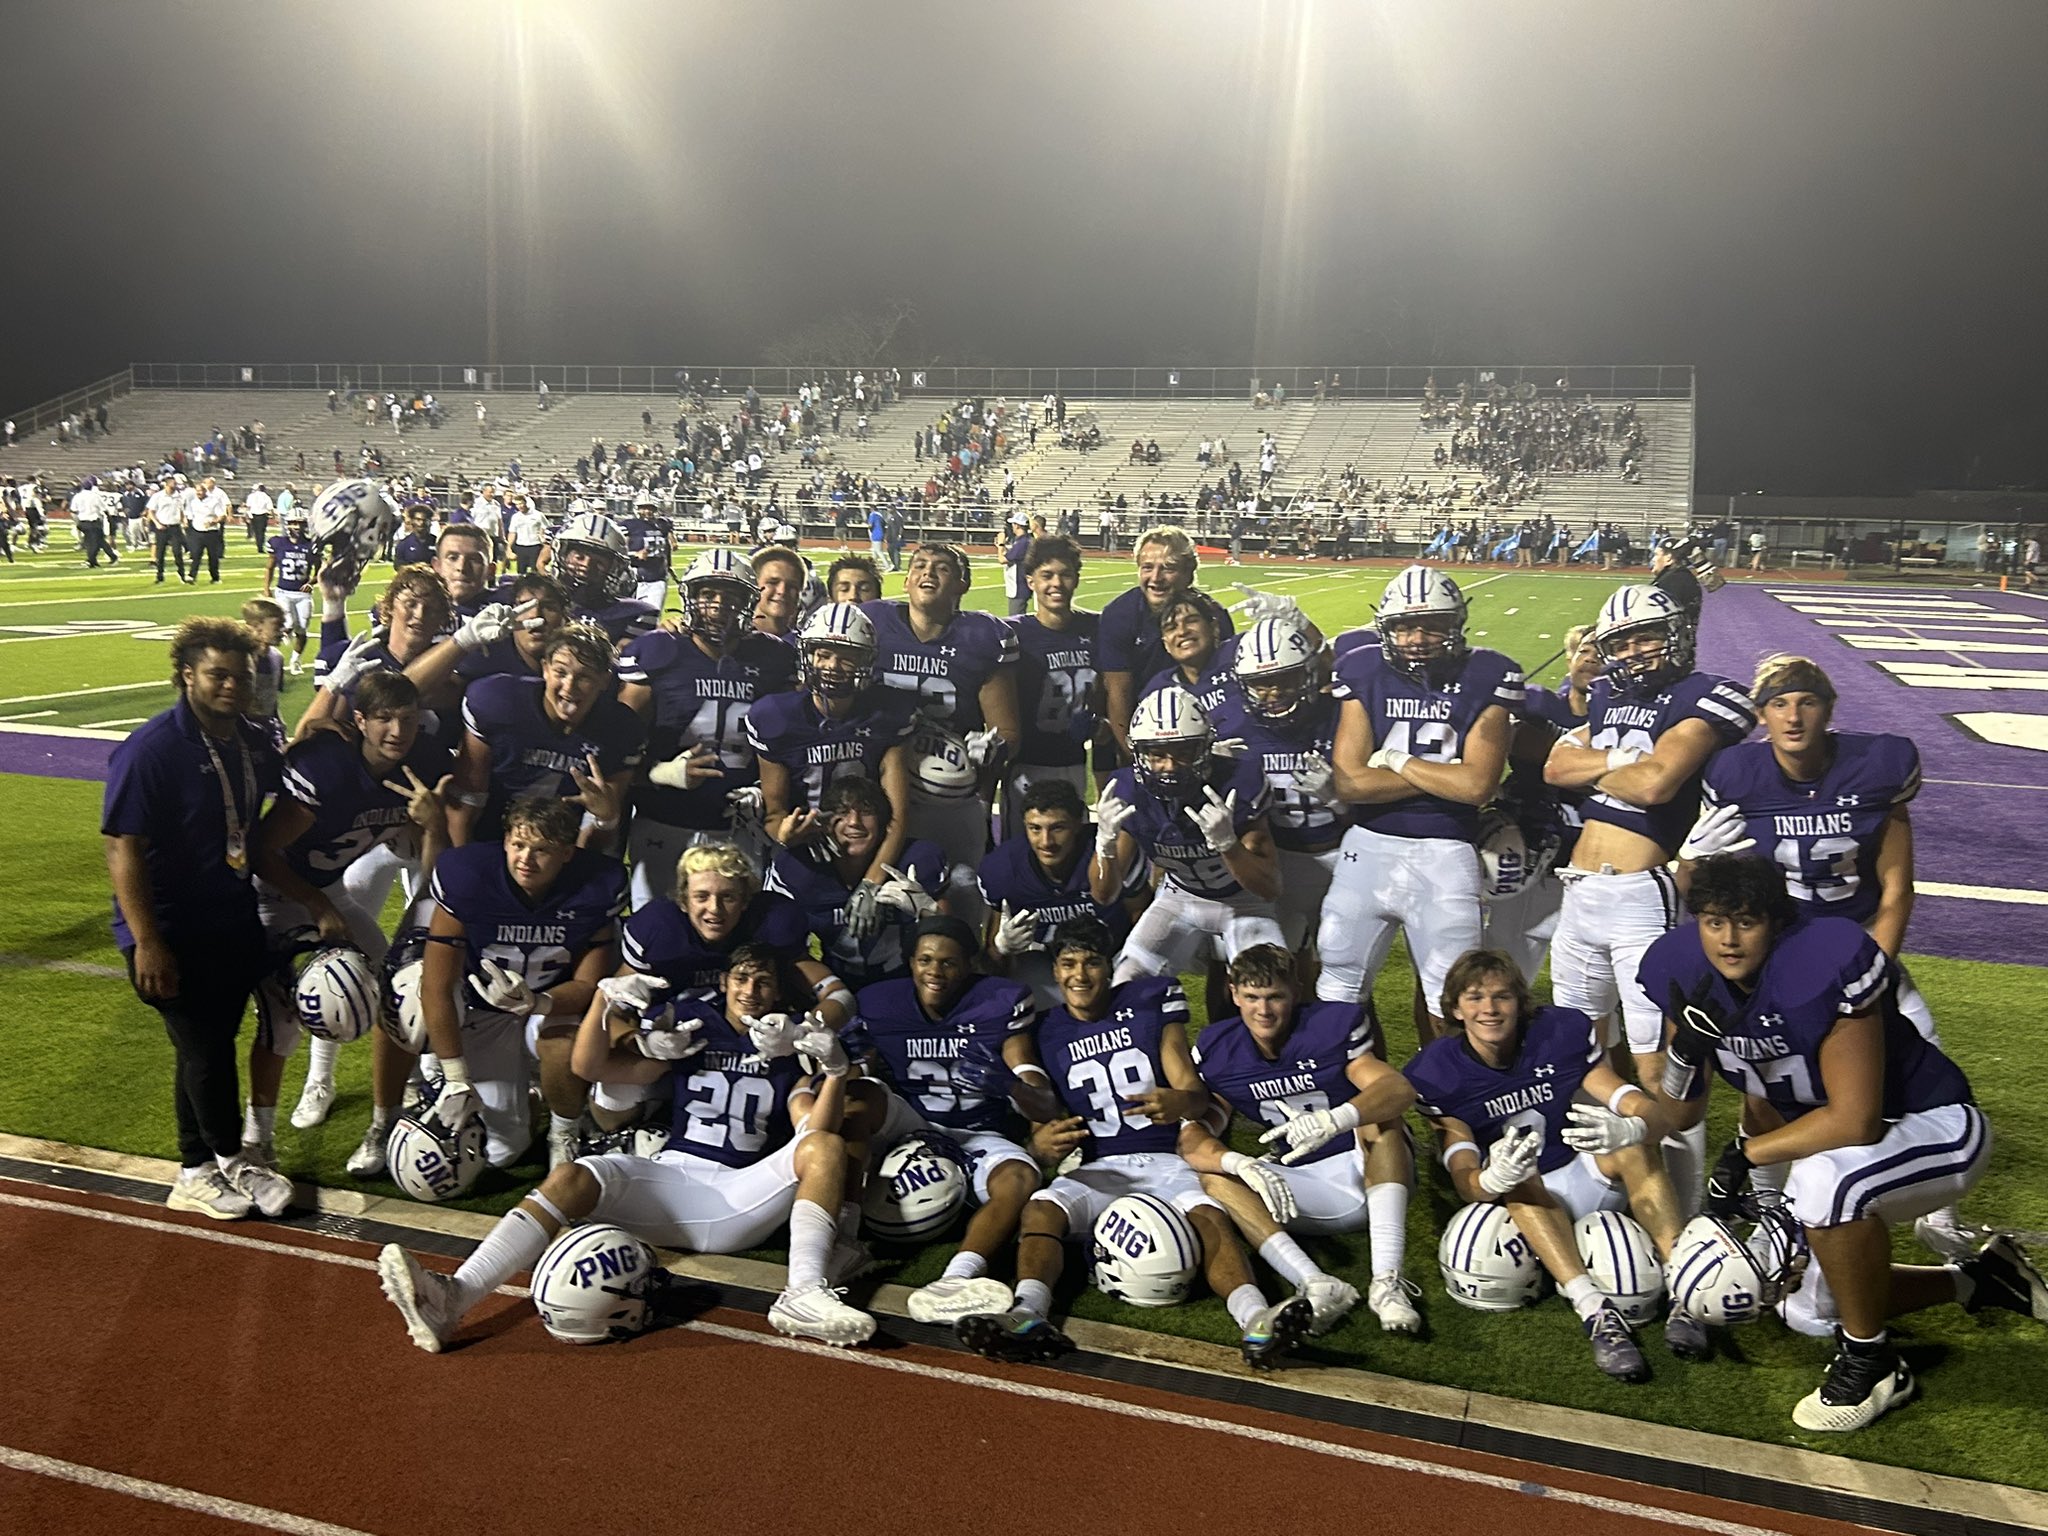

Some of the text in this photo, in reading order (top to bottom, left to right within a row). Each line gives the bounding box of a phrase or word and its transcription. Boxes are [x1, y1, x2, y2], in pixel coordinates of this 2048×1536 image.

[913, 374, 922, 385] K
[1170, 374, 1178, 384] L
[282, 558, 309, 580] 23
[893, 653, 949, 676] INDIANS
[1046, 650, 1091, 670] INDIANS
[696, 678, 754, 700] INDIANS
[1386, 698, 1452, 720] INDIANS
[1603, 705, 1657, 728] INDIANS
[1155, 730, 1179, 738] Riddell
[807, 741, 864, 764] INDIANS
[1263, 753, 1310, 771] INDIA
[1774, 812, 1852, 836] INDIANS
[1773, 837, 1860, 902] 13
[496, 925, 567, 943] INDIANS
[906, 1038, 969, 1059] INDIANS
[1067, 1026, 1132, 1061] INDIANS
[1720, 1035, 1791, 1060] NDIANS
[1249, 1073, 1317, 1100] INDIANS
[1715, 1048, 1829, 1107] 77
[1067, 1048, 1157, 1138] 39
[1484, 1082, 1555, 1118] INDIANS
[684, 1070, 775, 1152] 20
[415, 1151, 460, 1197] PNG
[1100, 1210, 1148, 1258] PNG
[574, 1245, 639, 1289] PNG
